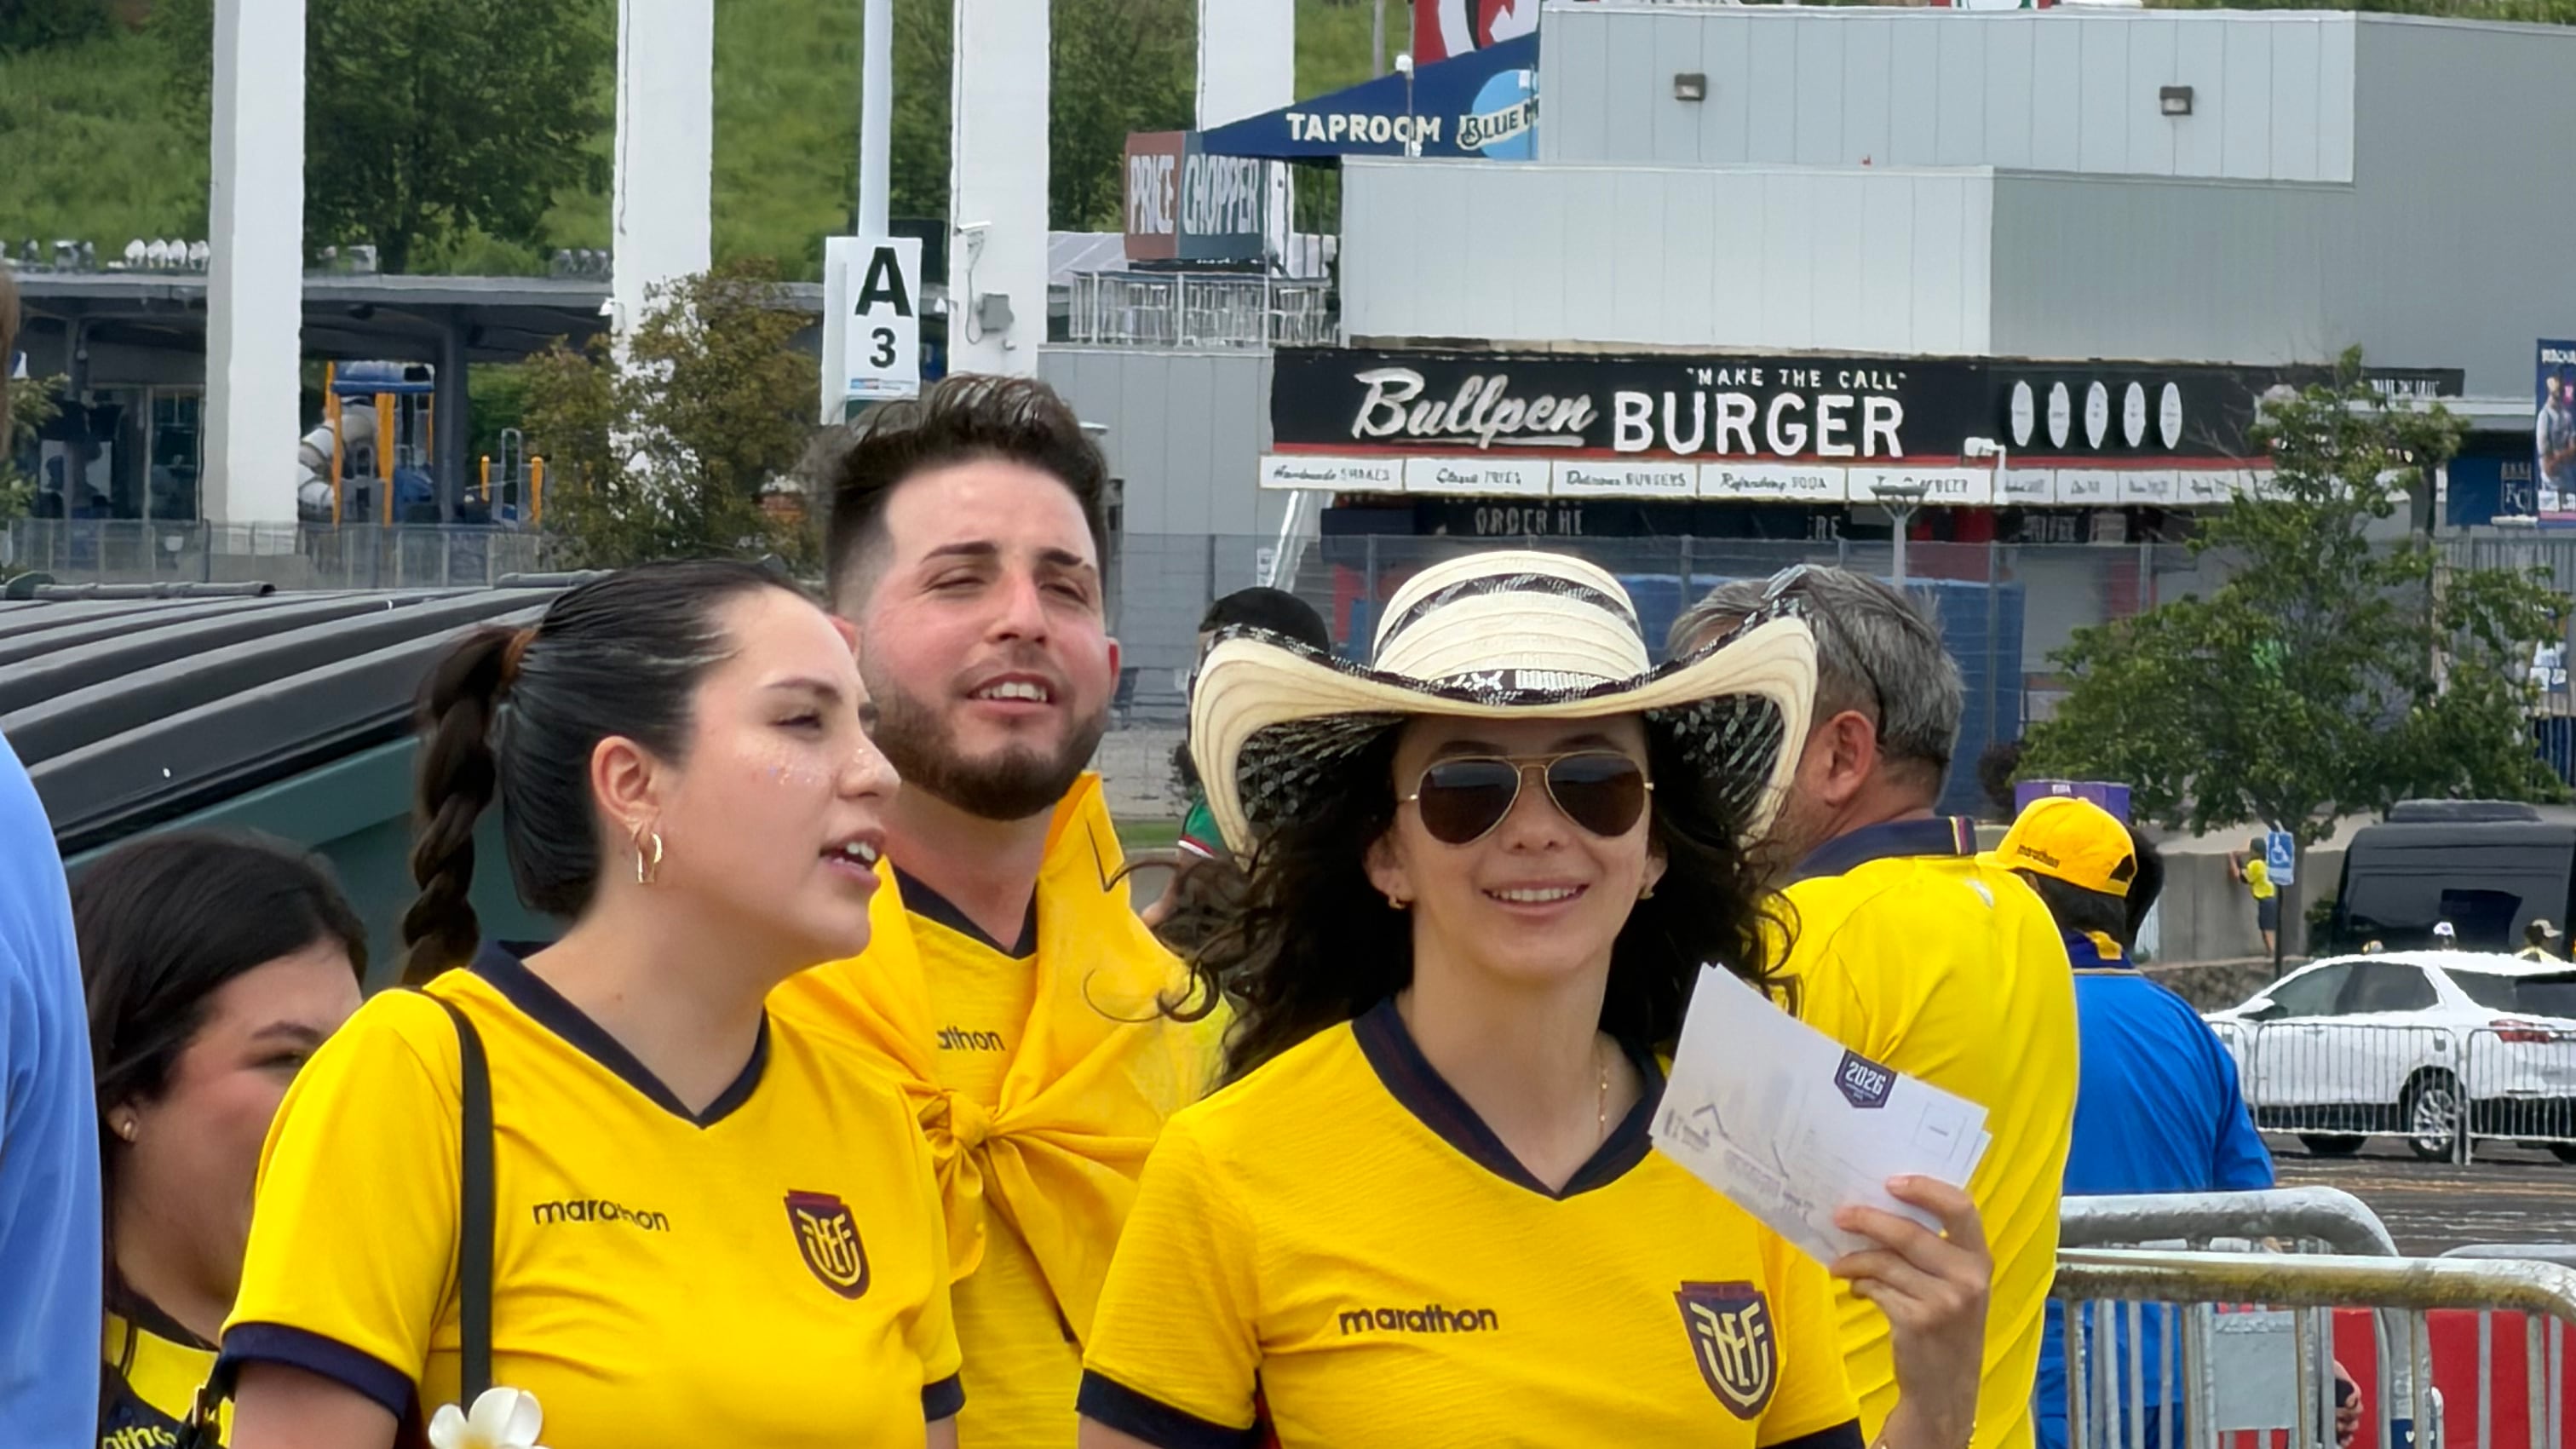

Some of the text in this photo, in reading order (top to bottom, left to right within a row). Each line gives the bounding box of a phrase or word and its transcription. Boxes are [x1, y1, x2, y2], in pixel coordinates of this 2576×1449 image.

[1285, 112, 1442, 144] TAPROOM
[1130, 152, 1260, 236] PRICE CHOPPER
[854, 246, 914, 318] A
[869, 327, 896, 368] 3
[1779, 369, 1822, 388] THE
[1350, 366, 1905, 457] Bullpen BURGER
[1845, 1061, 1887, 1095] 2026
[1339, 1304, 1499, 1336] marathon
